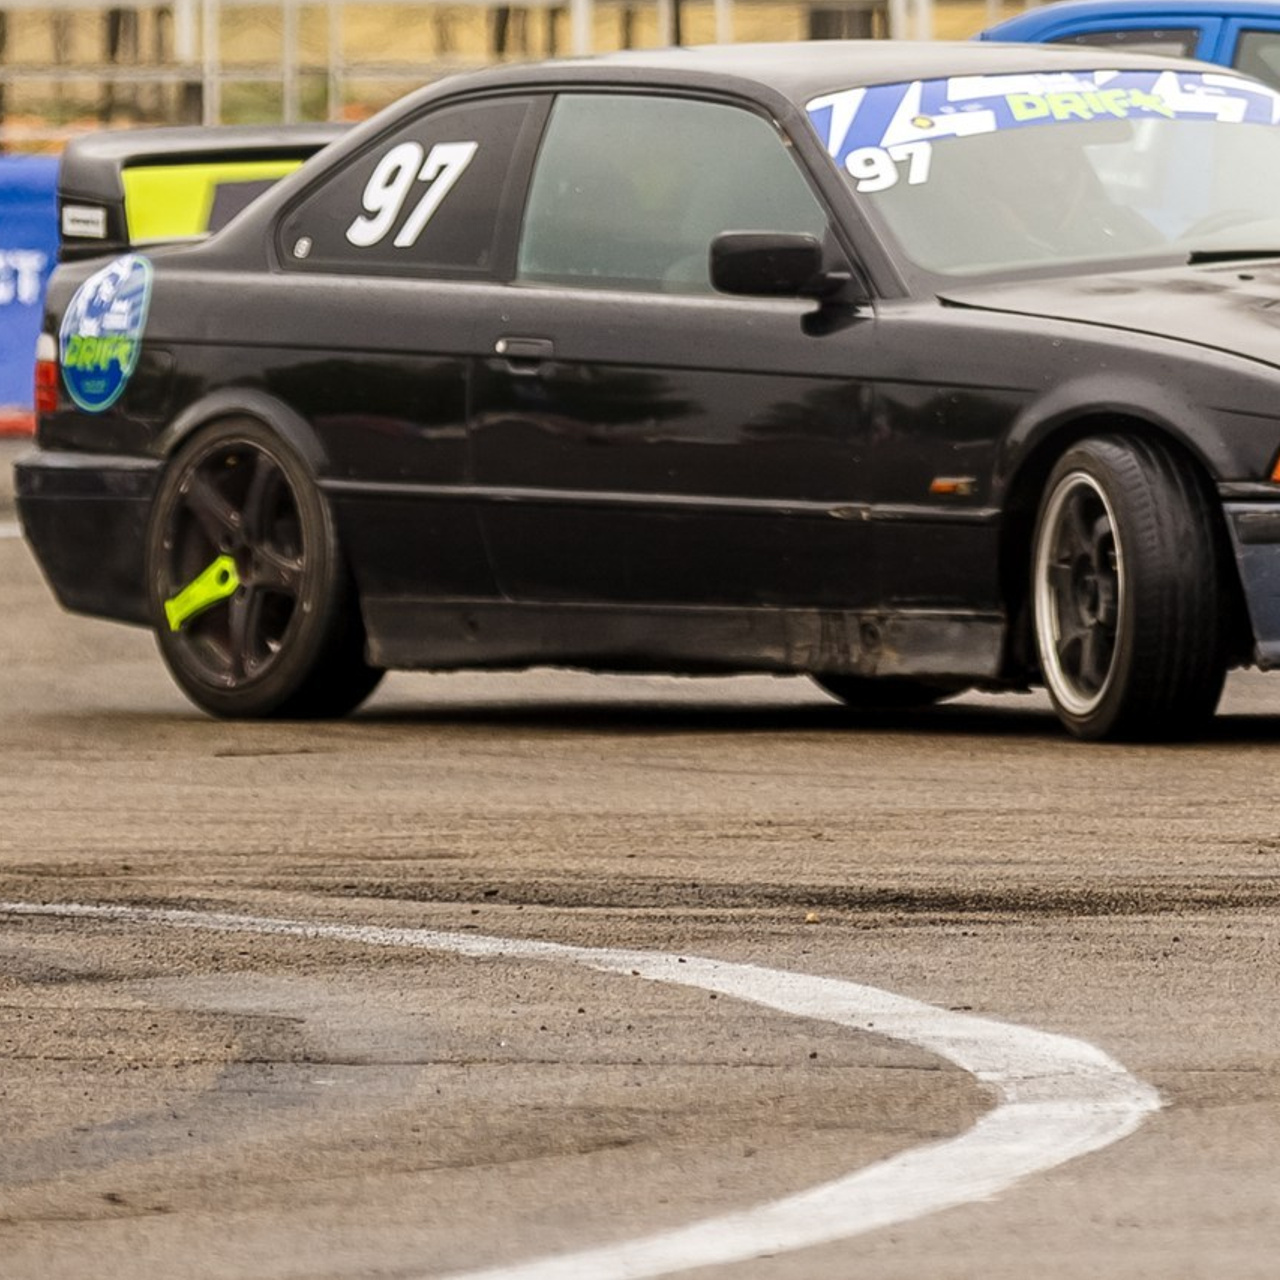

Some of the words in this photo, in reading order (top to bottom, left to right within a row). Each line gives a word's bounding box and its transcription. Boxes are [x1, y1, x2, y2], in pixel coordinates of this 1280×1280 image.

[1005, 88, 1175, 121] DRIFT
[844, 140, 932, 193] 97
[346, 141, 478, 247] 97
